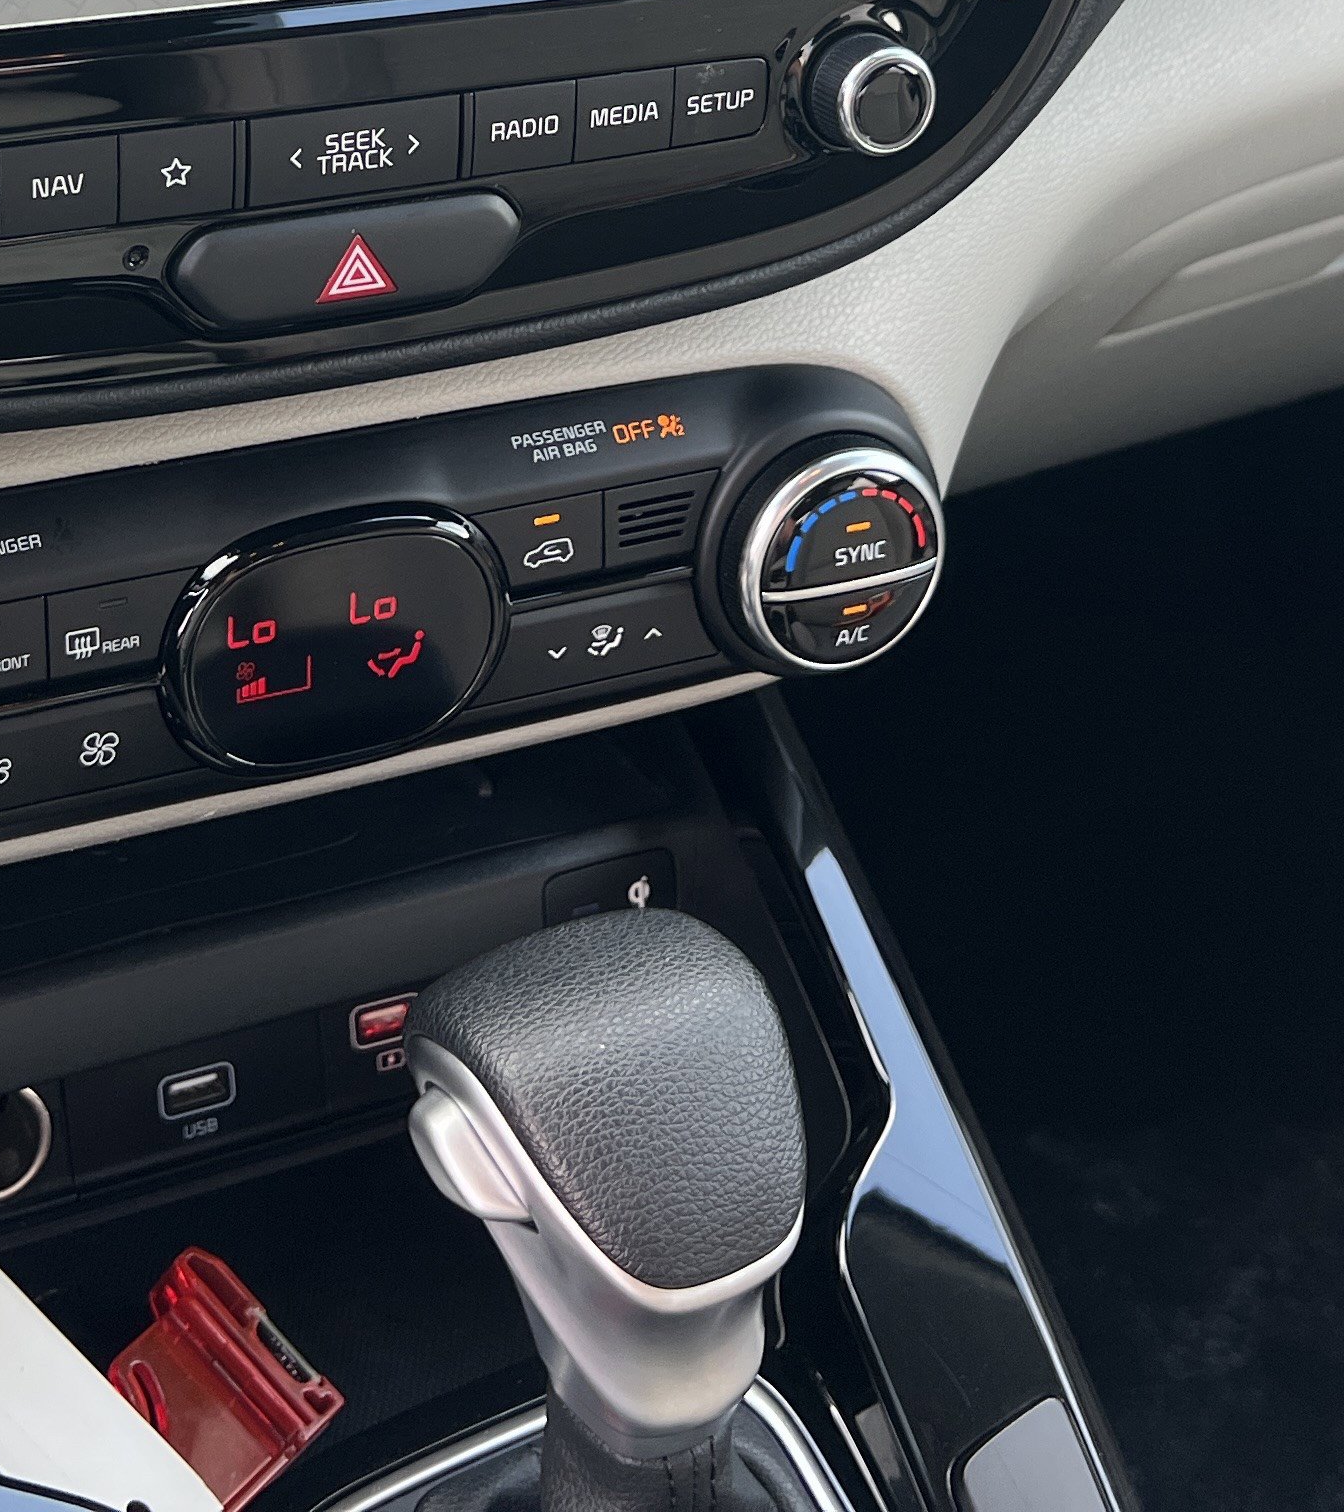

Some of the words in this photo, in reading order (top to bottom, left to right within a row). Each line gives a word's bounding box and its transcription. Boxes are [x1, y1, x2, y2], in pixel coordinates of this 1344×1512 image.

[590, 101, 659, 129] MEDIA
[687, 89, 754, 116] SETUP
[324, 128, 386, 153] SEEK
[491, 115, 560, 142] RADIO
[316, 148, 394, 175] TRACK
[31, 173, 85, 200] NAV
[511, 420, 607, 450] PASSENGER
[612, 419, 655, 445] OFF
[533, 445, 562, 463] AIR
[563, 439, 598, 459] BAG
[834, 539, 887, 567] SYNC
[349, 592, 399, 625] Lo
[102, 634, 140, 654] REAR
[227, 616, 277, 650] Lo
[835, 624, 870, 647] A/C
[183, 1117, 219, 1140] USB
